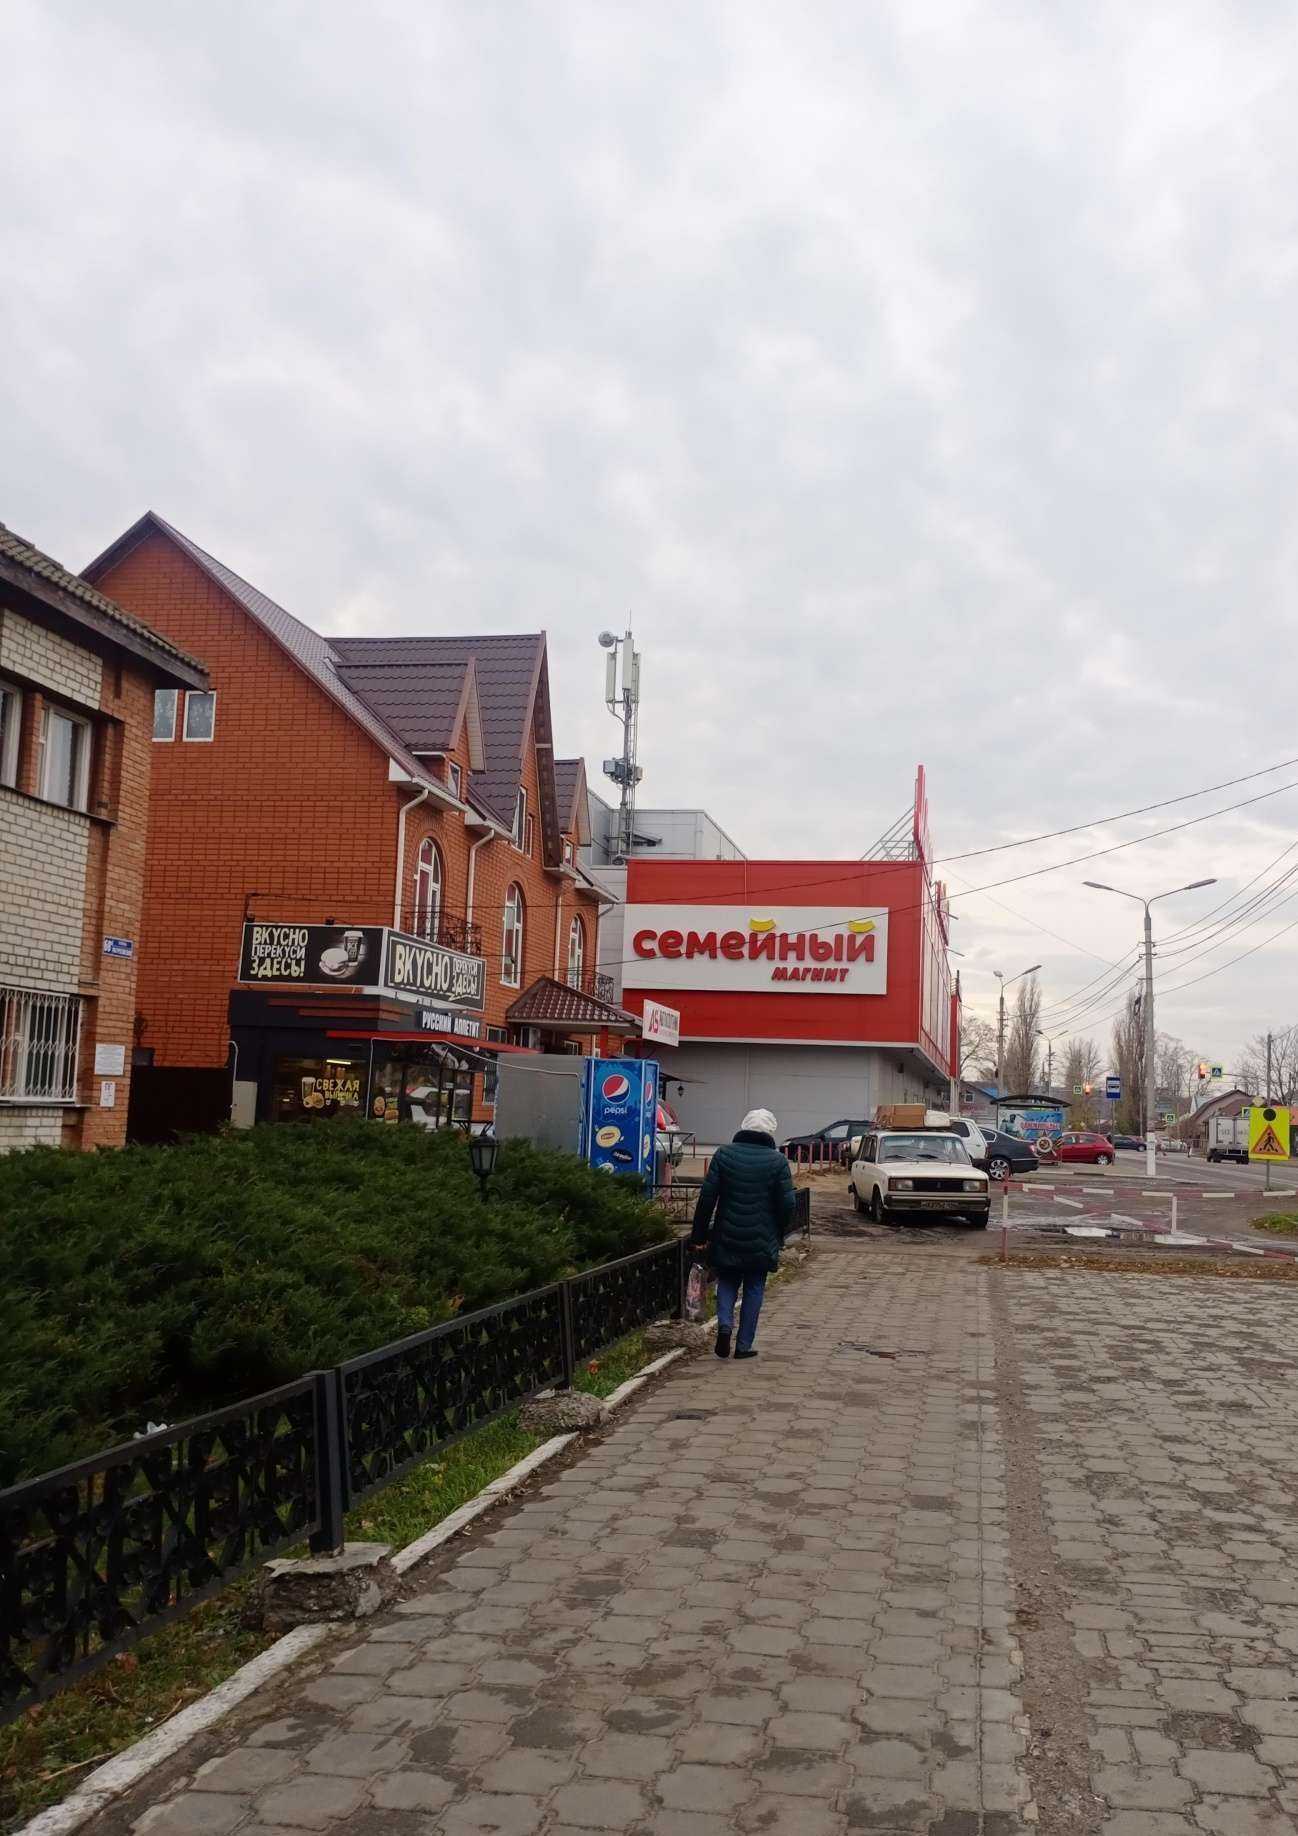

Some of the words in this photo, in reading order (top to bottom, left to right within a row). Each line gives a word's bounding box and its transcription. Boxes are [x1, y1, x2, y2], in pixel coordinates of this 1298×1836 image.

[253, 927, 308, 947] ВКУСНО
[251, 944, 306, 959] ПЕРЕКУСИ
[250, 957, 305, 978] ЗДЕСЬ!
[394, 944, 450, 991] ВКУСНО
[452, 957, 478, 976] ПЕРЕКУСИ
[451, 971, 478, 996] ЗДЕСЬ!
[421, 1010, 452, 1033] РУССКИЙ
[453, 1017, 480, 1038] АППЕТИТ
